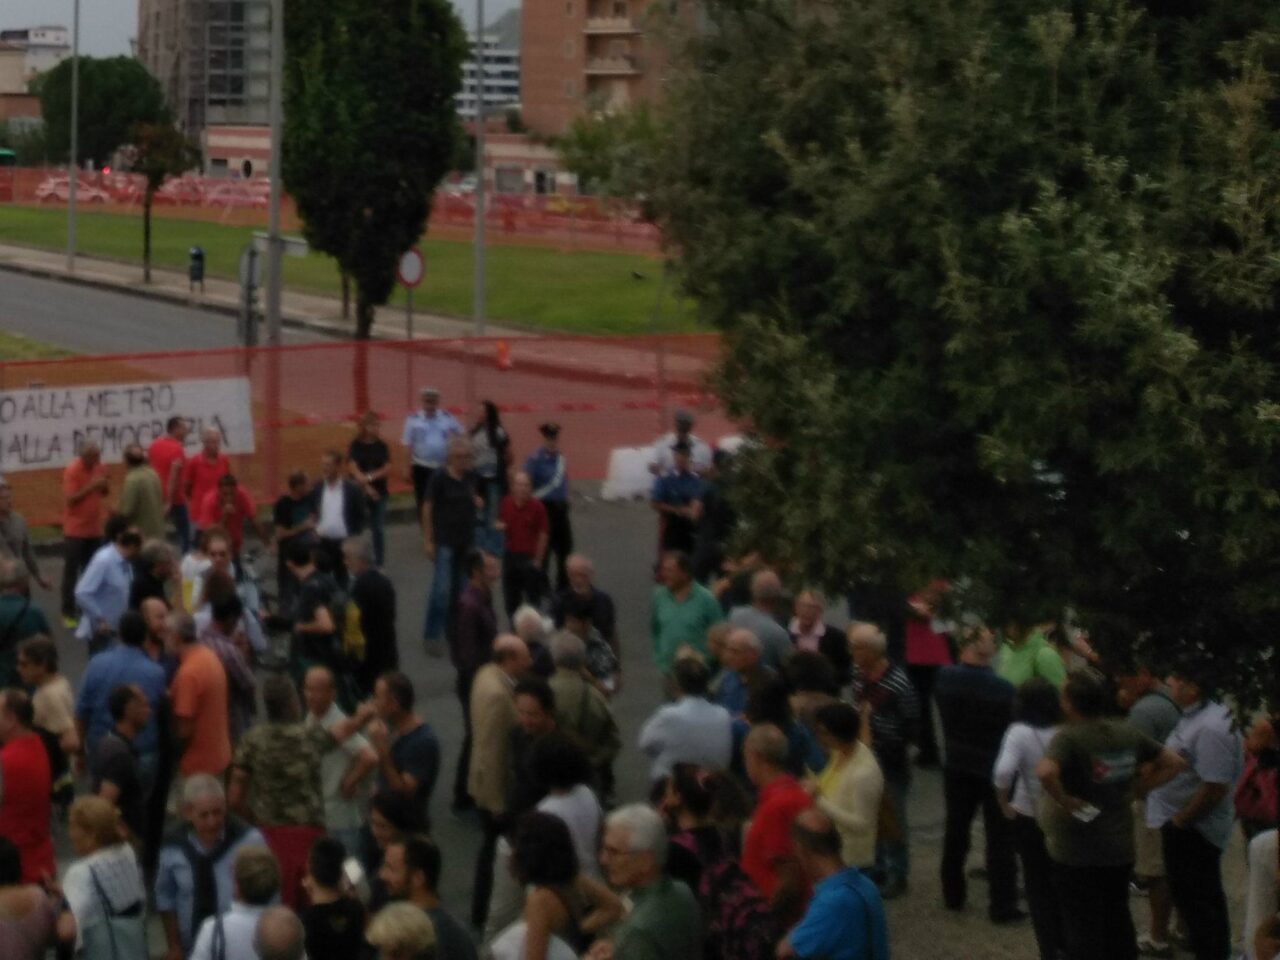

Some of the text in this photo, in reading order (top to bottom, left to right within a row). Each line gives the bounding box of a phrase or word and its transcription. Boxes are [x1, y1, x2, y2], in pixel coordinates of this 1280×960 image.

[23, 392, 74, 421] ALLA
[84, 385, 175, 418] METRO
[8, 431, 61, 464] ALLA
